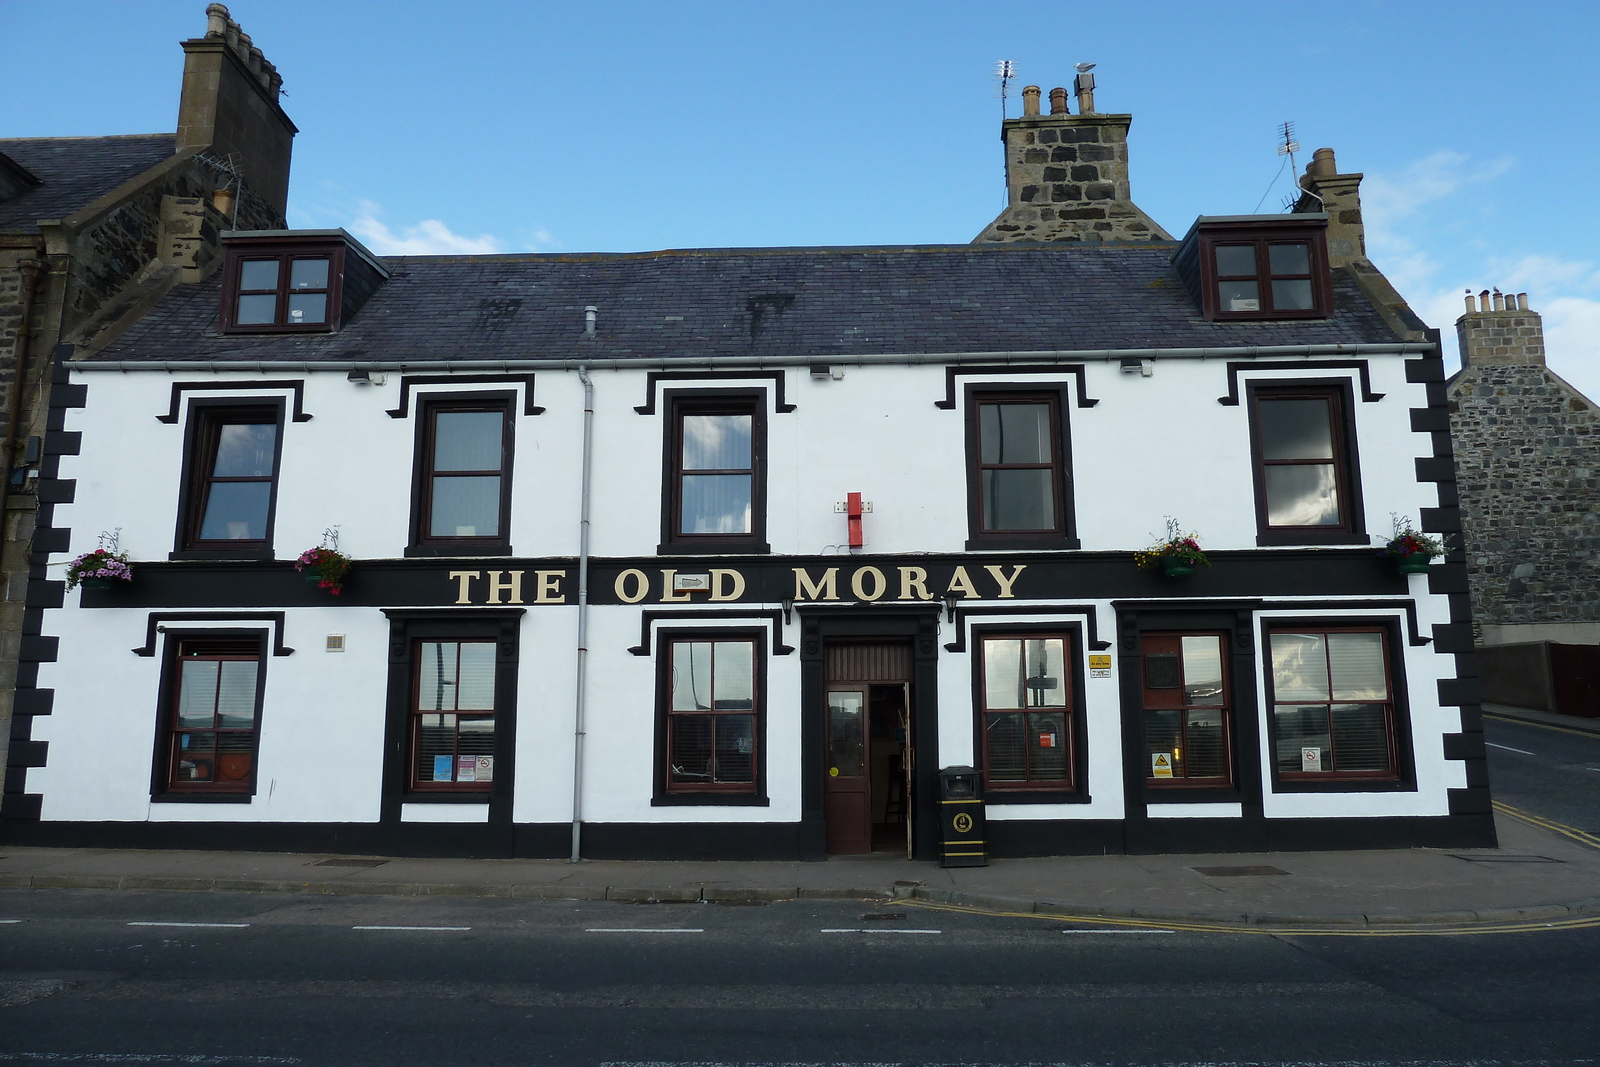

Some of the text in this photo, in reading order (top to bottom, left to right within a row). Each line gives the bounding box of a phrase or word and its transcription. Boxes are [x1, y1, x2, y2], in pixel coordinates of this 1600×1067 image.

[449, 565, 1027, 604] THE OLD MORAY
